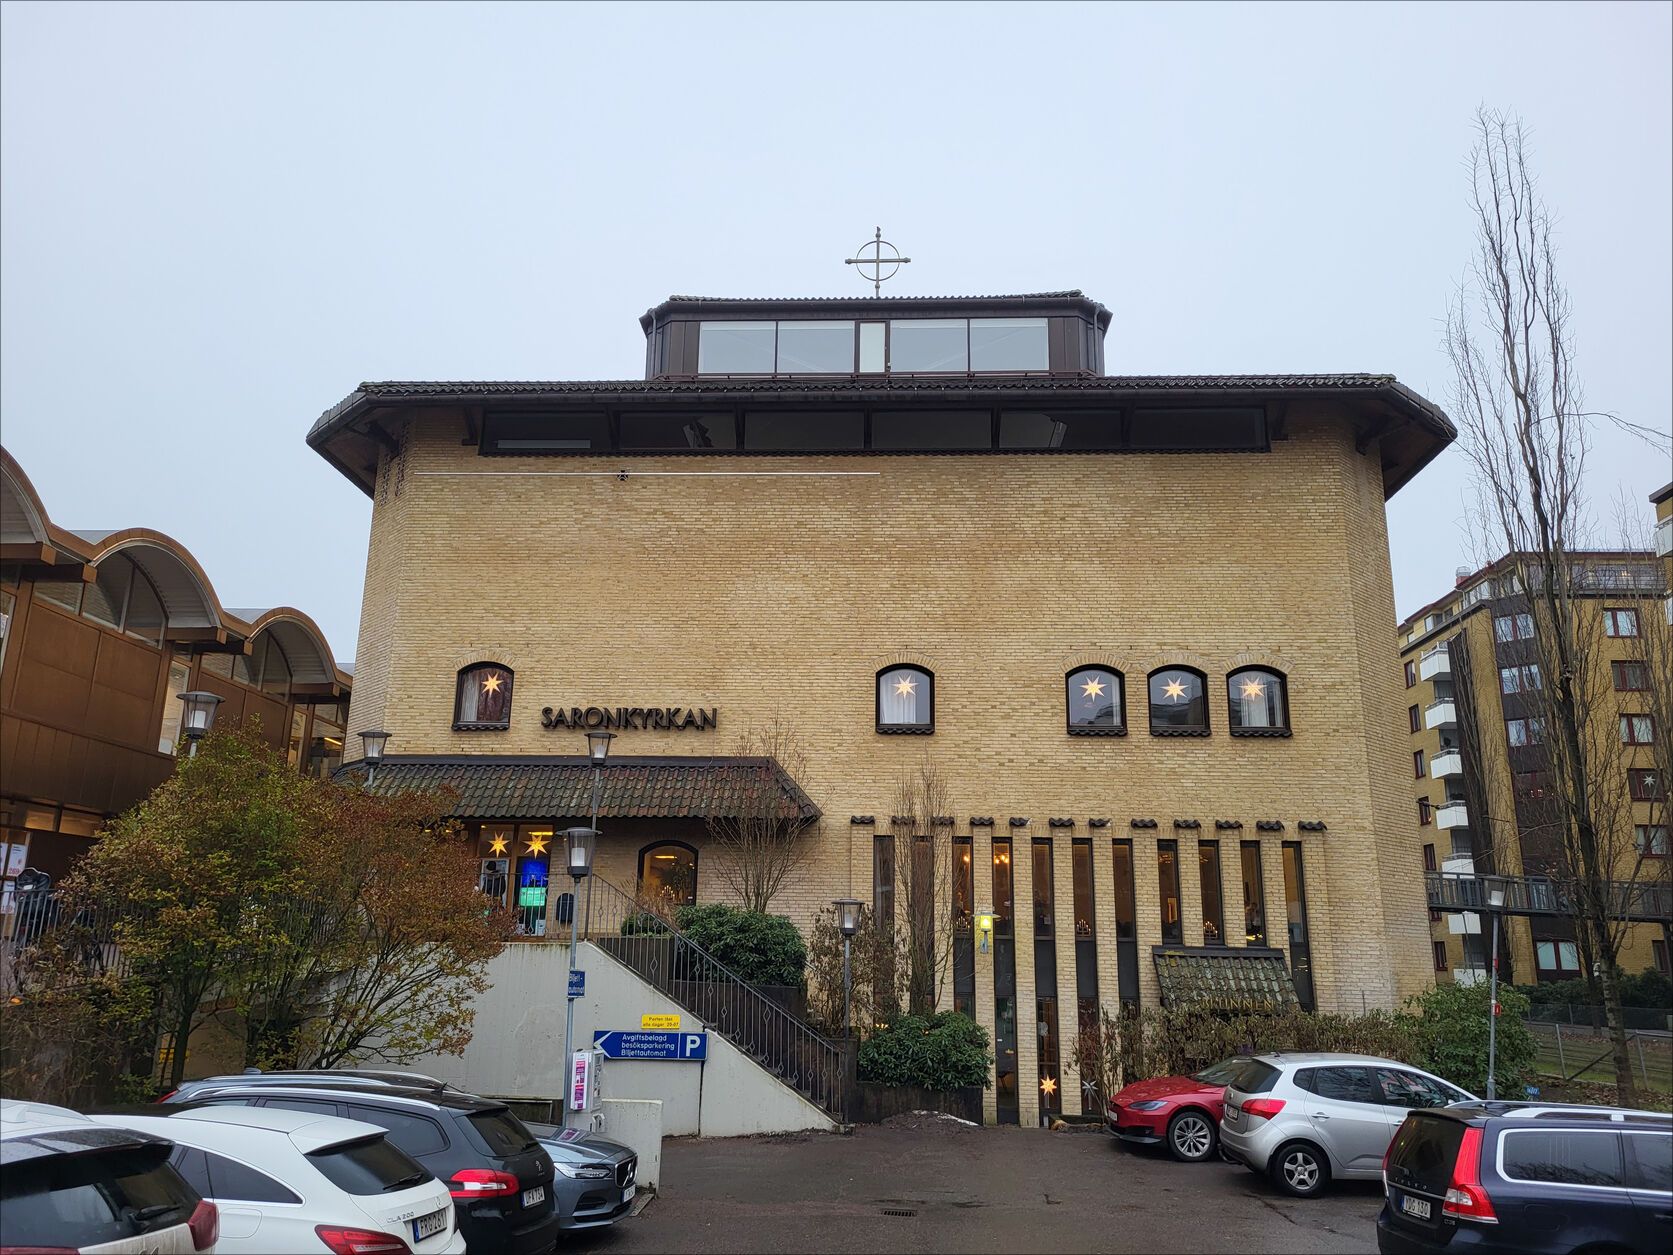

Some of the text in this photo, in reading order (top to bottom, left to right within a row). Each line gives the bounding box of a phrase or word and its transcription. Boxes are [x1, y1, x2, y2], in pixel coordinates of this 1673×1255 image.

[541, 706, 718, 730] SARONKYRKAN
[621, 1042, 675, 1051] besöksparkering
[621, 1049, 666, 1057] Biljettautomat
[622, 1034, 701, 1057] Avgiftsbelagd P
